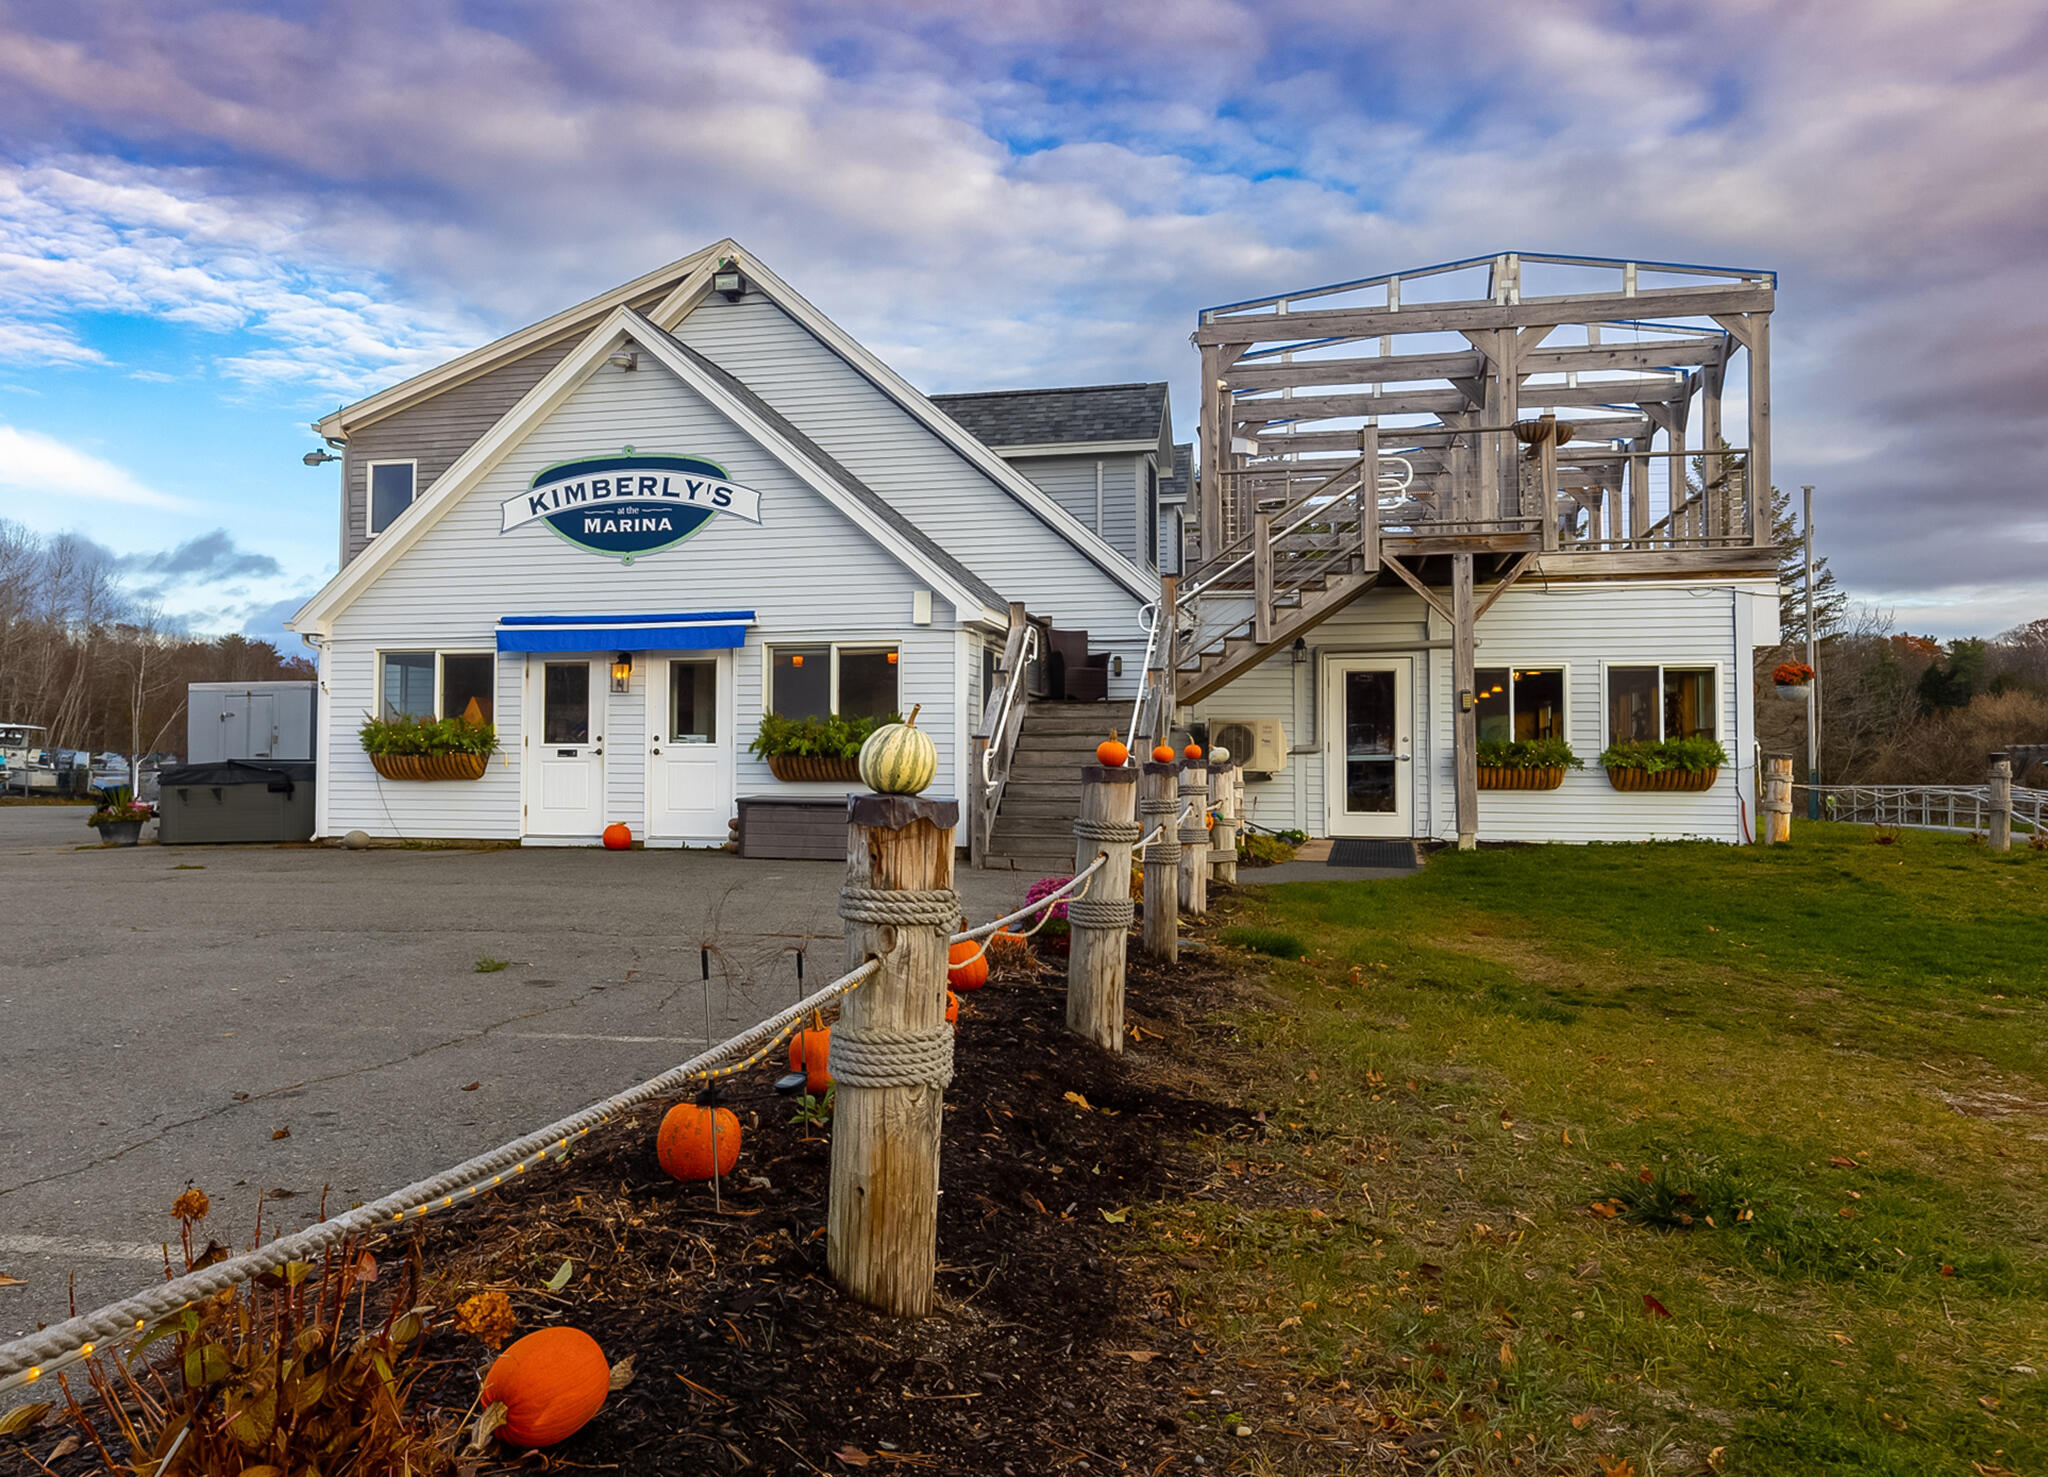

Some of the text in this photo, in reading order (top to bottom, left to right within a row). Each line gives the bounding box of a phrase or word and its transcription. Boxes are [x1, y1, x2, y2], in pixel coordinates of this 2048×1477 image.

[528, 476, 734, 516] KIMBERLY'S
[617, 506, 640, 515] at the
[584, 518, 673, 533] MARINA
